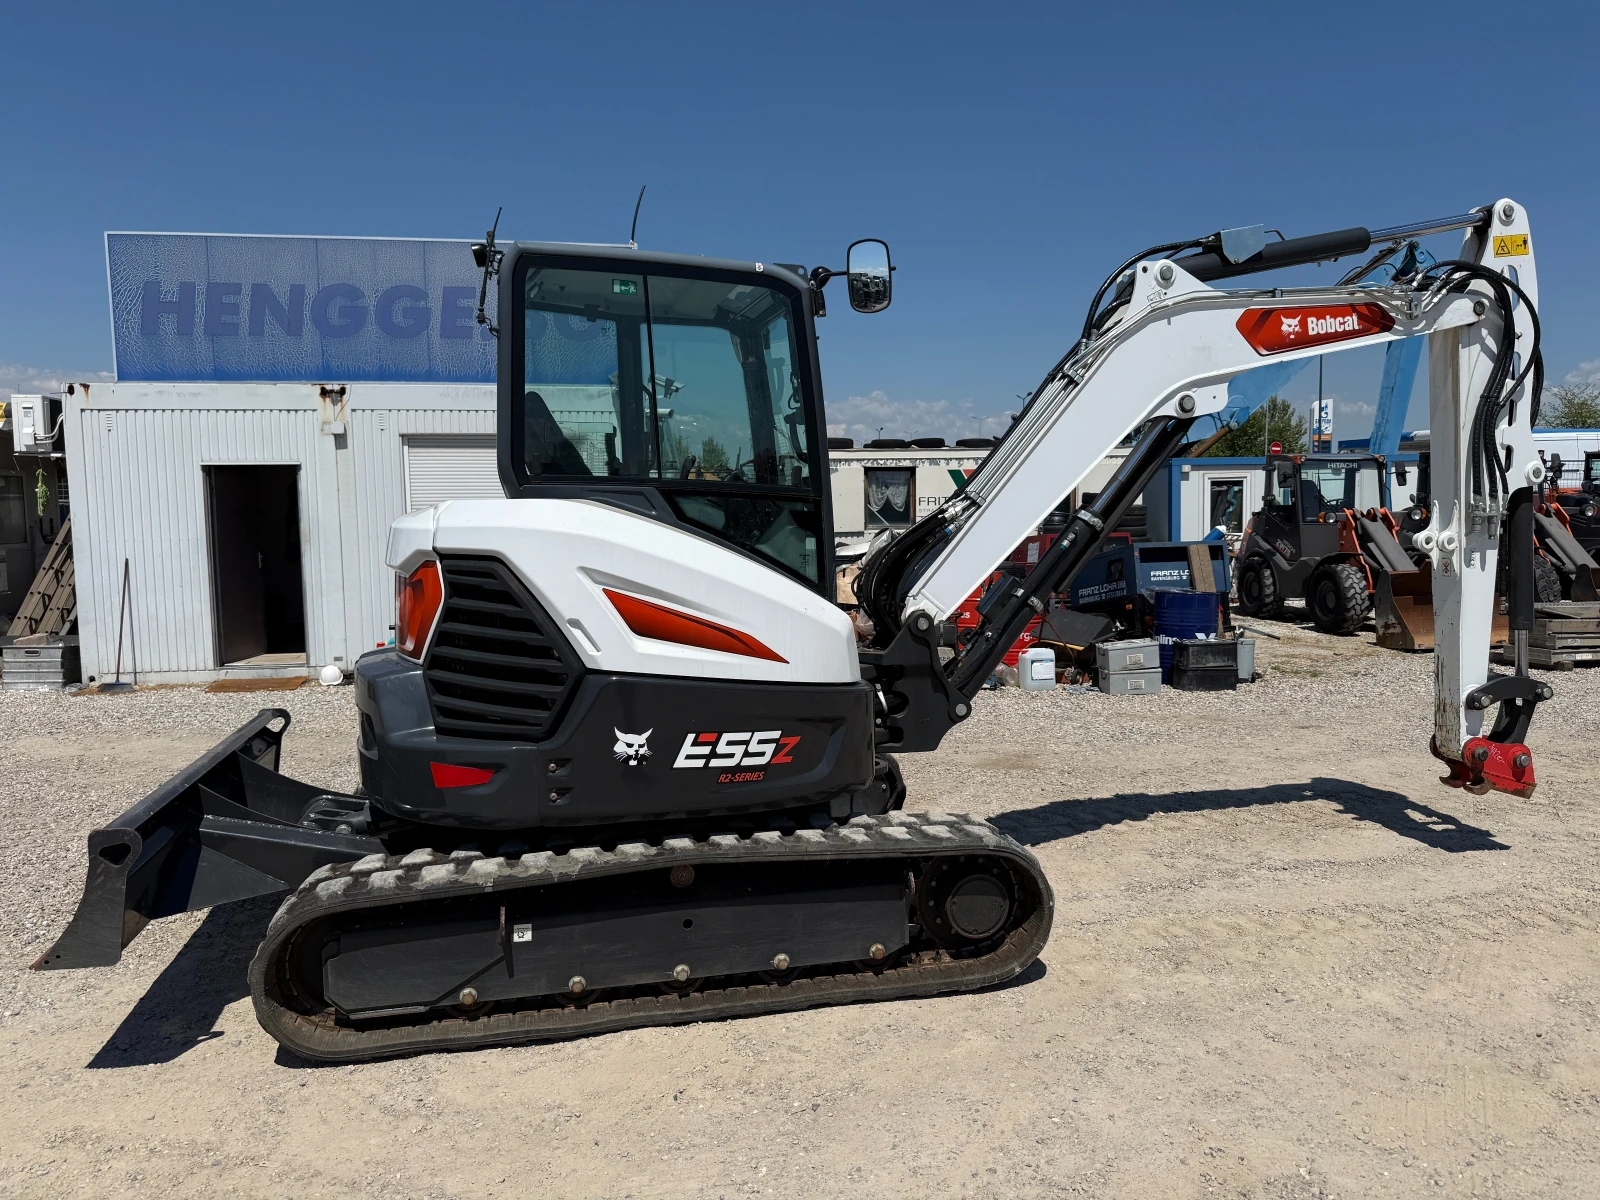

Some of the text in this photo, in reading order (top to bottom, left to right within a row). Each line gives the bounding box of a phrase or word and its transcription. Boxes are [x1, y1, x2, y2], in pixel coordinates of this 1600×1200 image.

[1307, 313, 1359, 335] Bobcat
[1078, 586, 1099, 597] FRANZ
[718, 771, 765, 783] R2-SERIES
